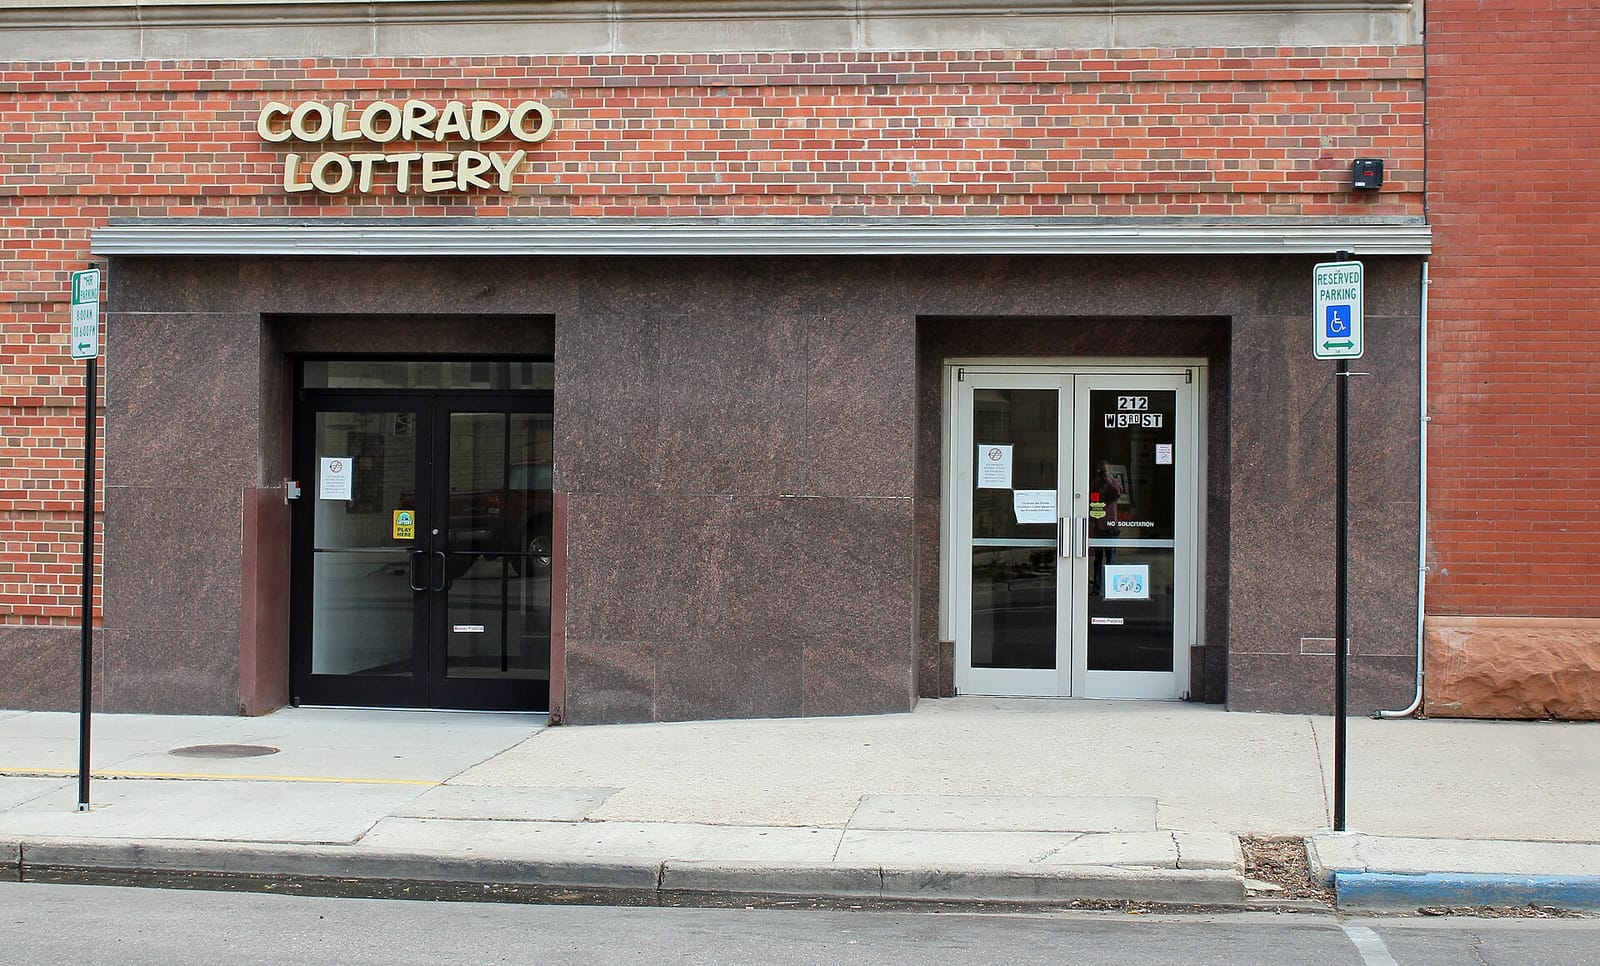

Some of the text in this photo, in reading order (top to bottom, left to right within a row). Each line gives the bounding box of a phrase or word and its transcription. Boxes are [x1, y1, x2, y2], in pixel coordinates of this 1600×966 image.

[258, 101, 554, 143] COLORADO
[283, 150, 526, 193] LOTTERY
[1317, 272, 1360, 285] RESERVED
[80, 288, 97, 300] PARKING
[1320, 288, 1357, 301] PARKING
[74, 327, 79, 338] TO
[1119, 397, 1147, 409] 212
[1105, 414, 1162, 427] W 3RD ST
